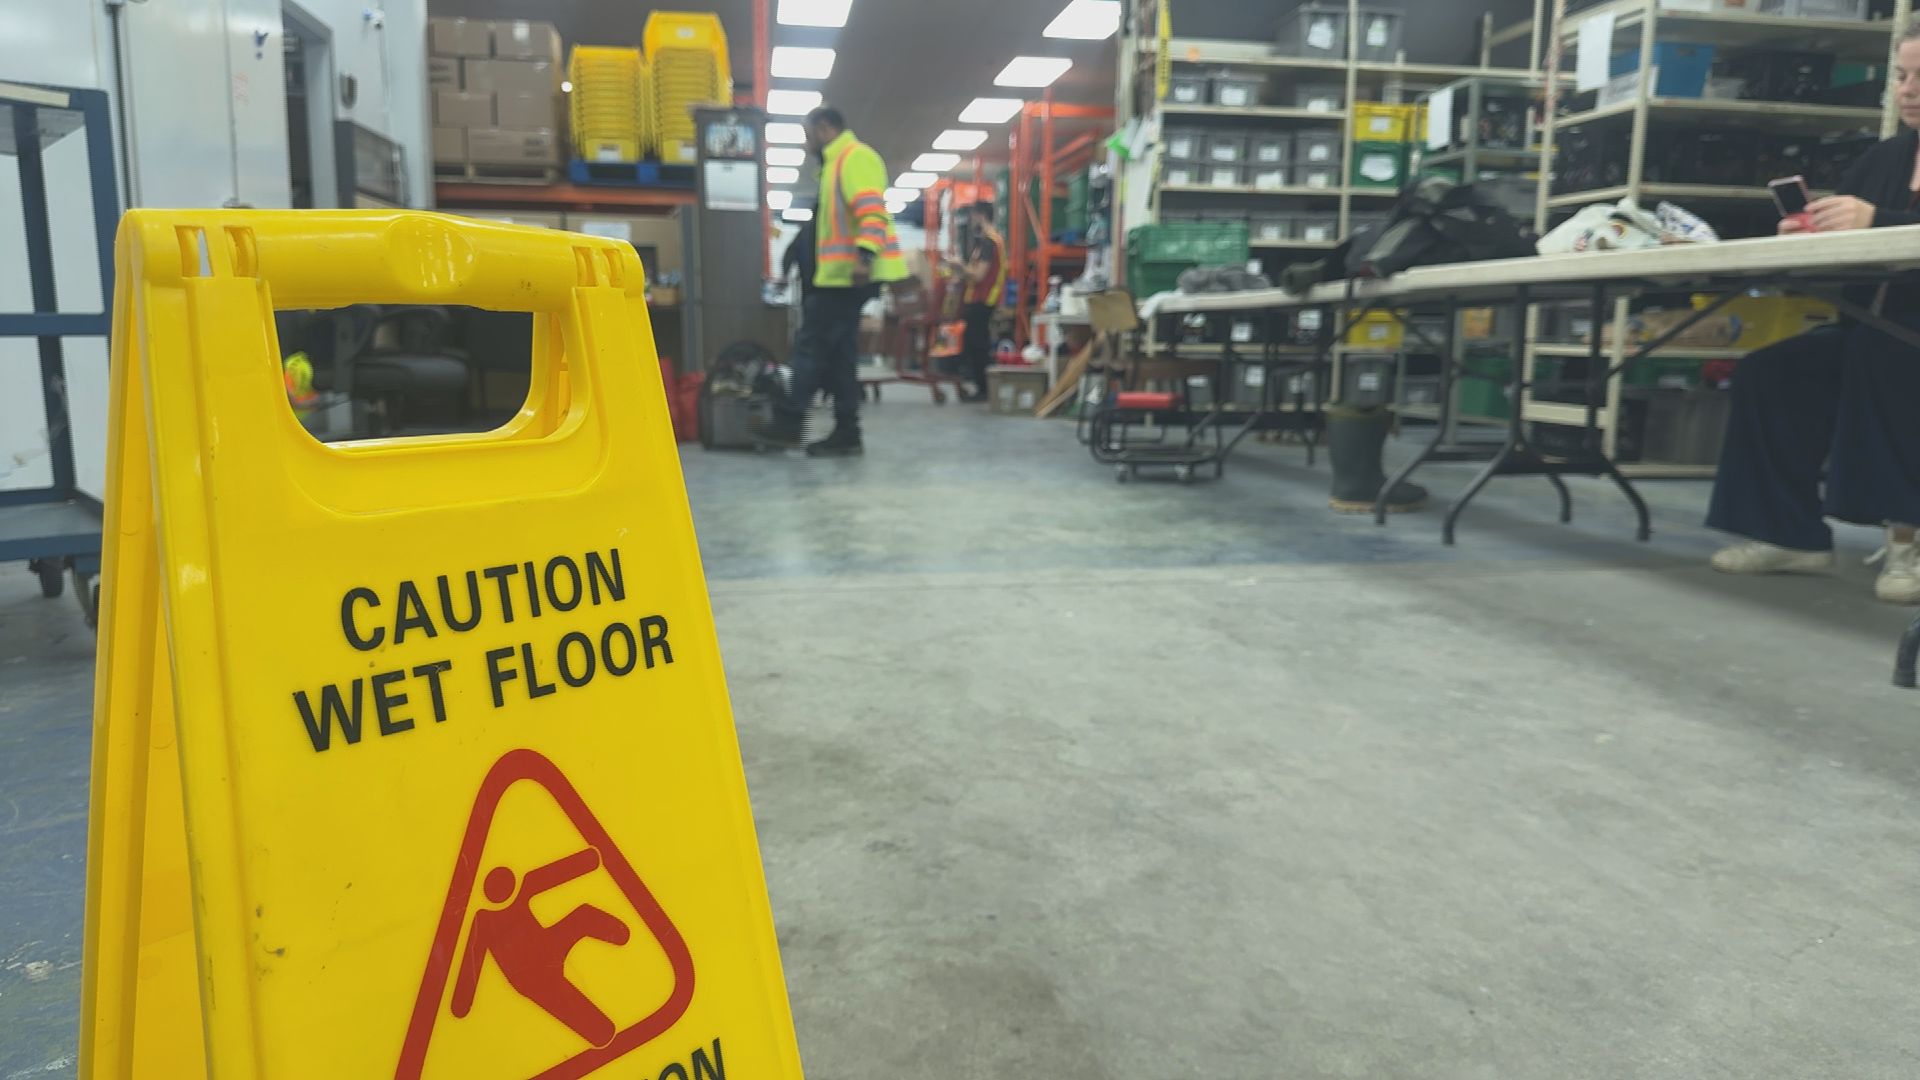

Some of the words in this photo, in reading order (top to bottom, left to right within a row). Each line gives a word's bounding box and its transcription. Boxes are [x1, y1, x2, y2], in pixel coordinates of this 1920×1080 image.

[340, 548, 627, 652] CAUTION
[292, 659, 453, 753] WET
[485, 614, 675, 708] FLOOR
